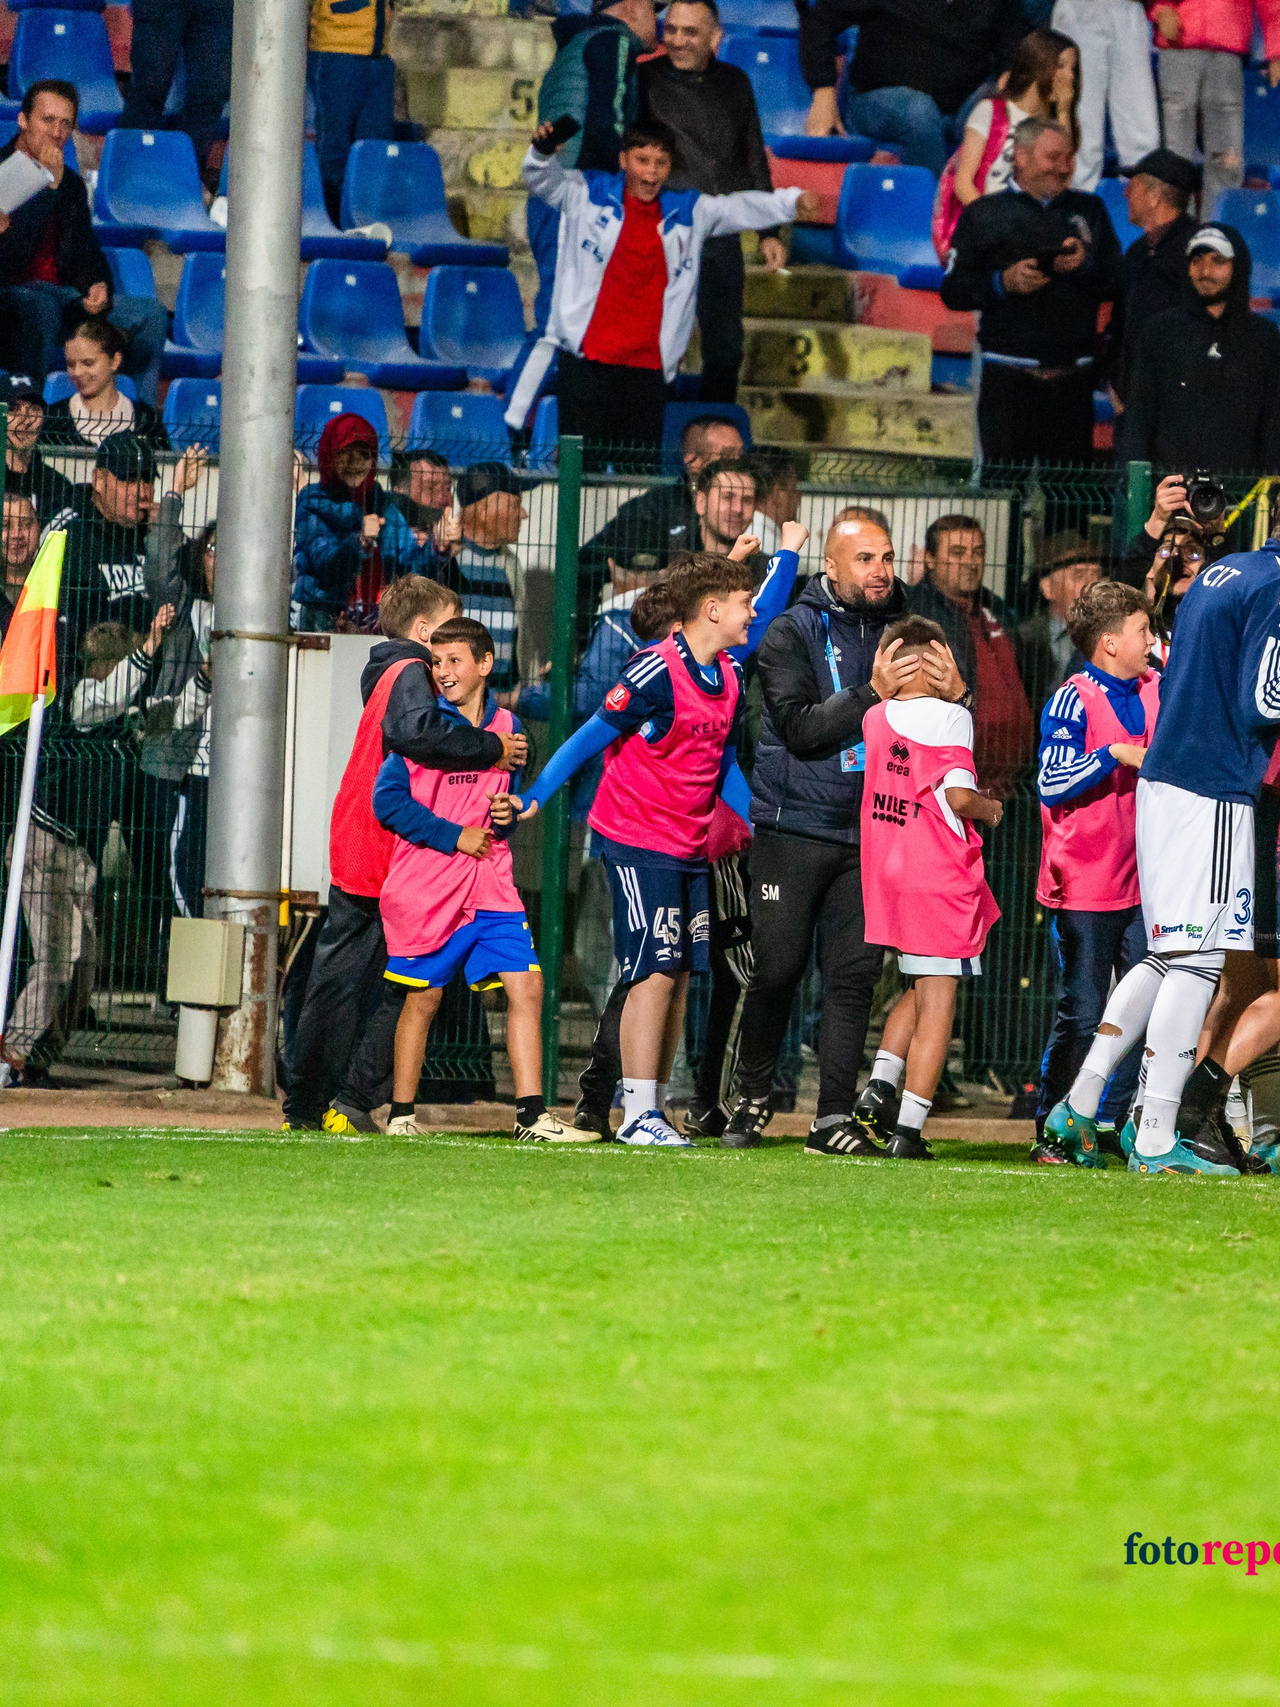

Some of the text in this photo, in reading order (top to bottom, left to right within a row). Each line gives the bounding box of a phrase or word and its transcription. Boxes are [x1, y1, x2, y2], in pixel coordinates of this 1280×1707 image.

[448, 773, 479, 786] errea
[761, 884, 781, 901] SM
[1234, 887, 1256, 926] 3
[652, 906, 682, 946] 45
[1160, 923, 1203, 934] Smart Eco
[1187, 932, 1203, 940] Plus
[1143, 1118, 1160, 1130] 32
